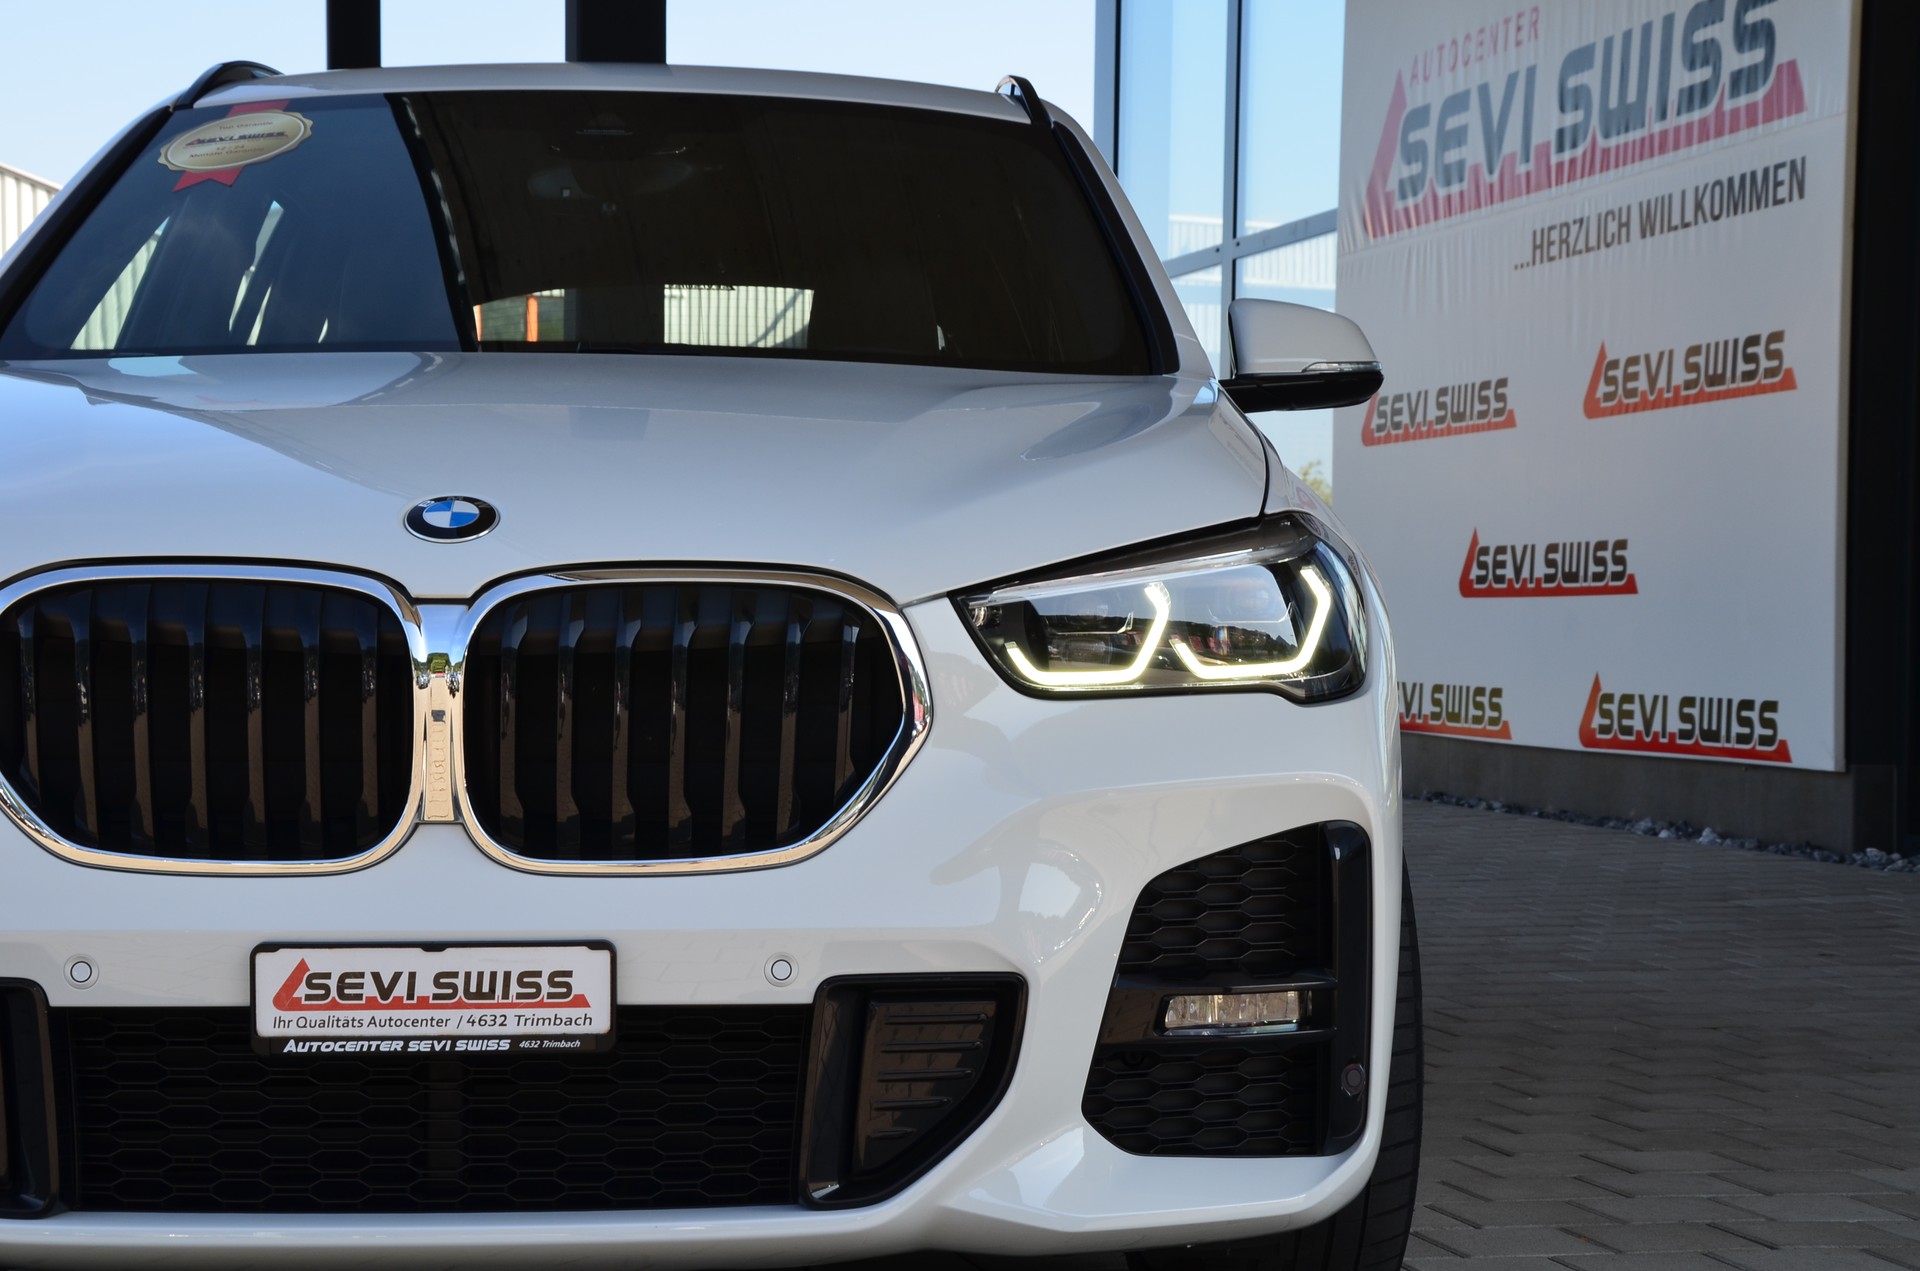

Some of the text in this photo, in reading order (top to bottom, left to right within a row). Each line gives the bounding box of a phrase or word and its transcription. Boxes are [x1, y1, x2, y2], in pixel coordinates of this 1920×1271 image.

[1410, 6, 1540, 87] AUTOCENTER
[1398, 0, 1778, 201] SEVI SWISS
[1514, 156, 1807, 270] ...HERZLICH WILLKOMMEN
[1601, 329, 1786, 403] SEVI SWISS
[1375, 377, 1509, 434] SEVI SWISS
[1475, 538, 1628, 585] SEVI SWISS
[1430, 683, 1503, 727] SWISS
[1597, 692, 1779, 748] SEVI SWISS
[304, 969, 573, 1002] SEVI SWISS
[272, 1016, 294, 1029] Ihr
[295, 1015, 364, 1029] Qualitäts
[367, 1015, 451, 1029] Autocenter
[466, 1014, 508, 1028] 4632
[513, 1013, 593, 1027] Trimbach
[407, 1040, 452, 1052] SEVI
[454, 1039, 511, 1052] SWISS
[519, 1039, 540, 1049] 4632
[541, 1039, 581, 1049] Trimbach
